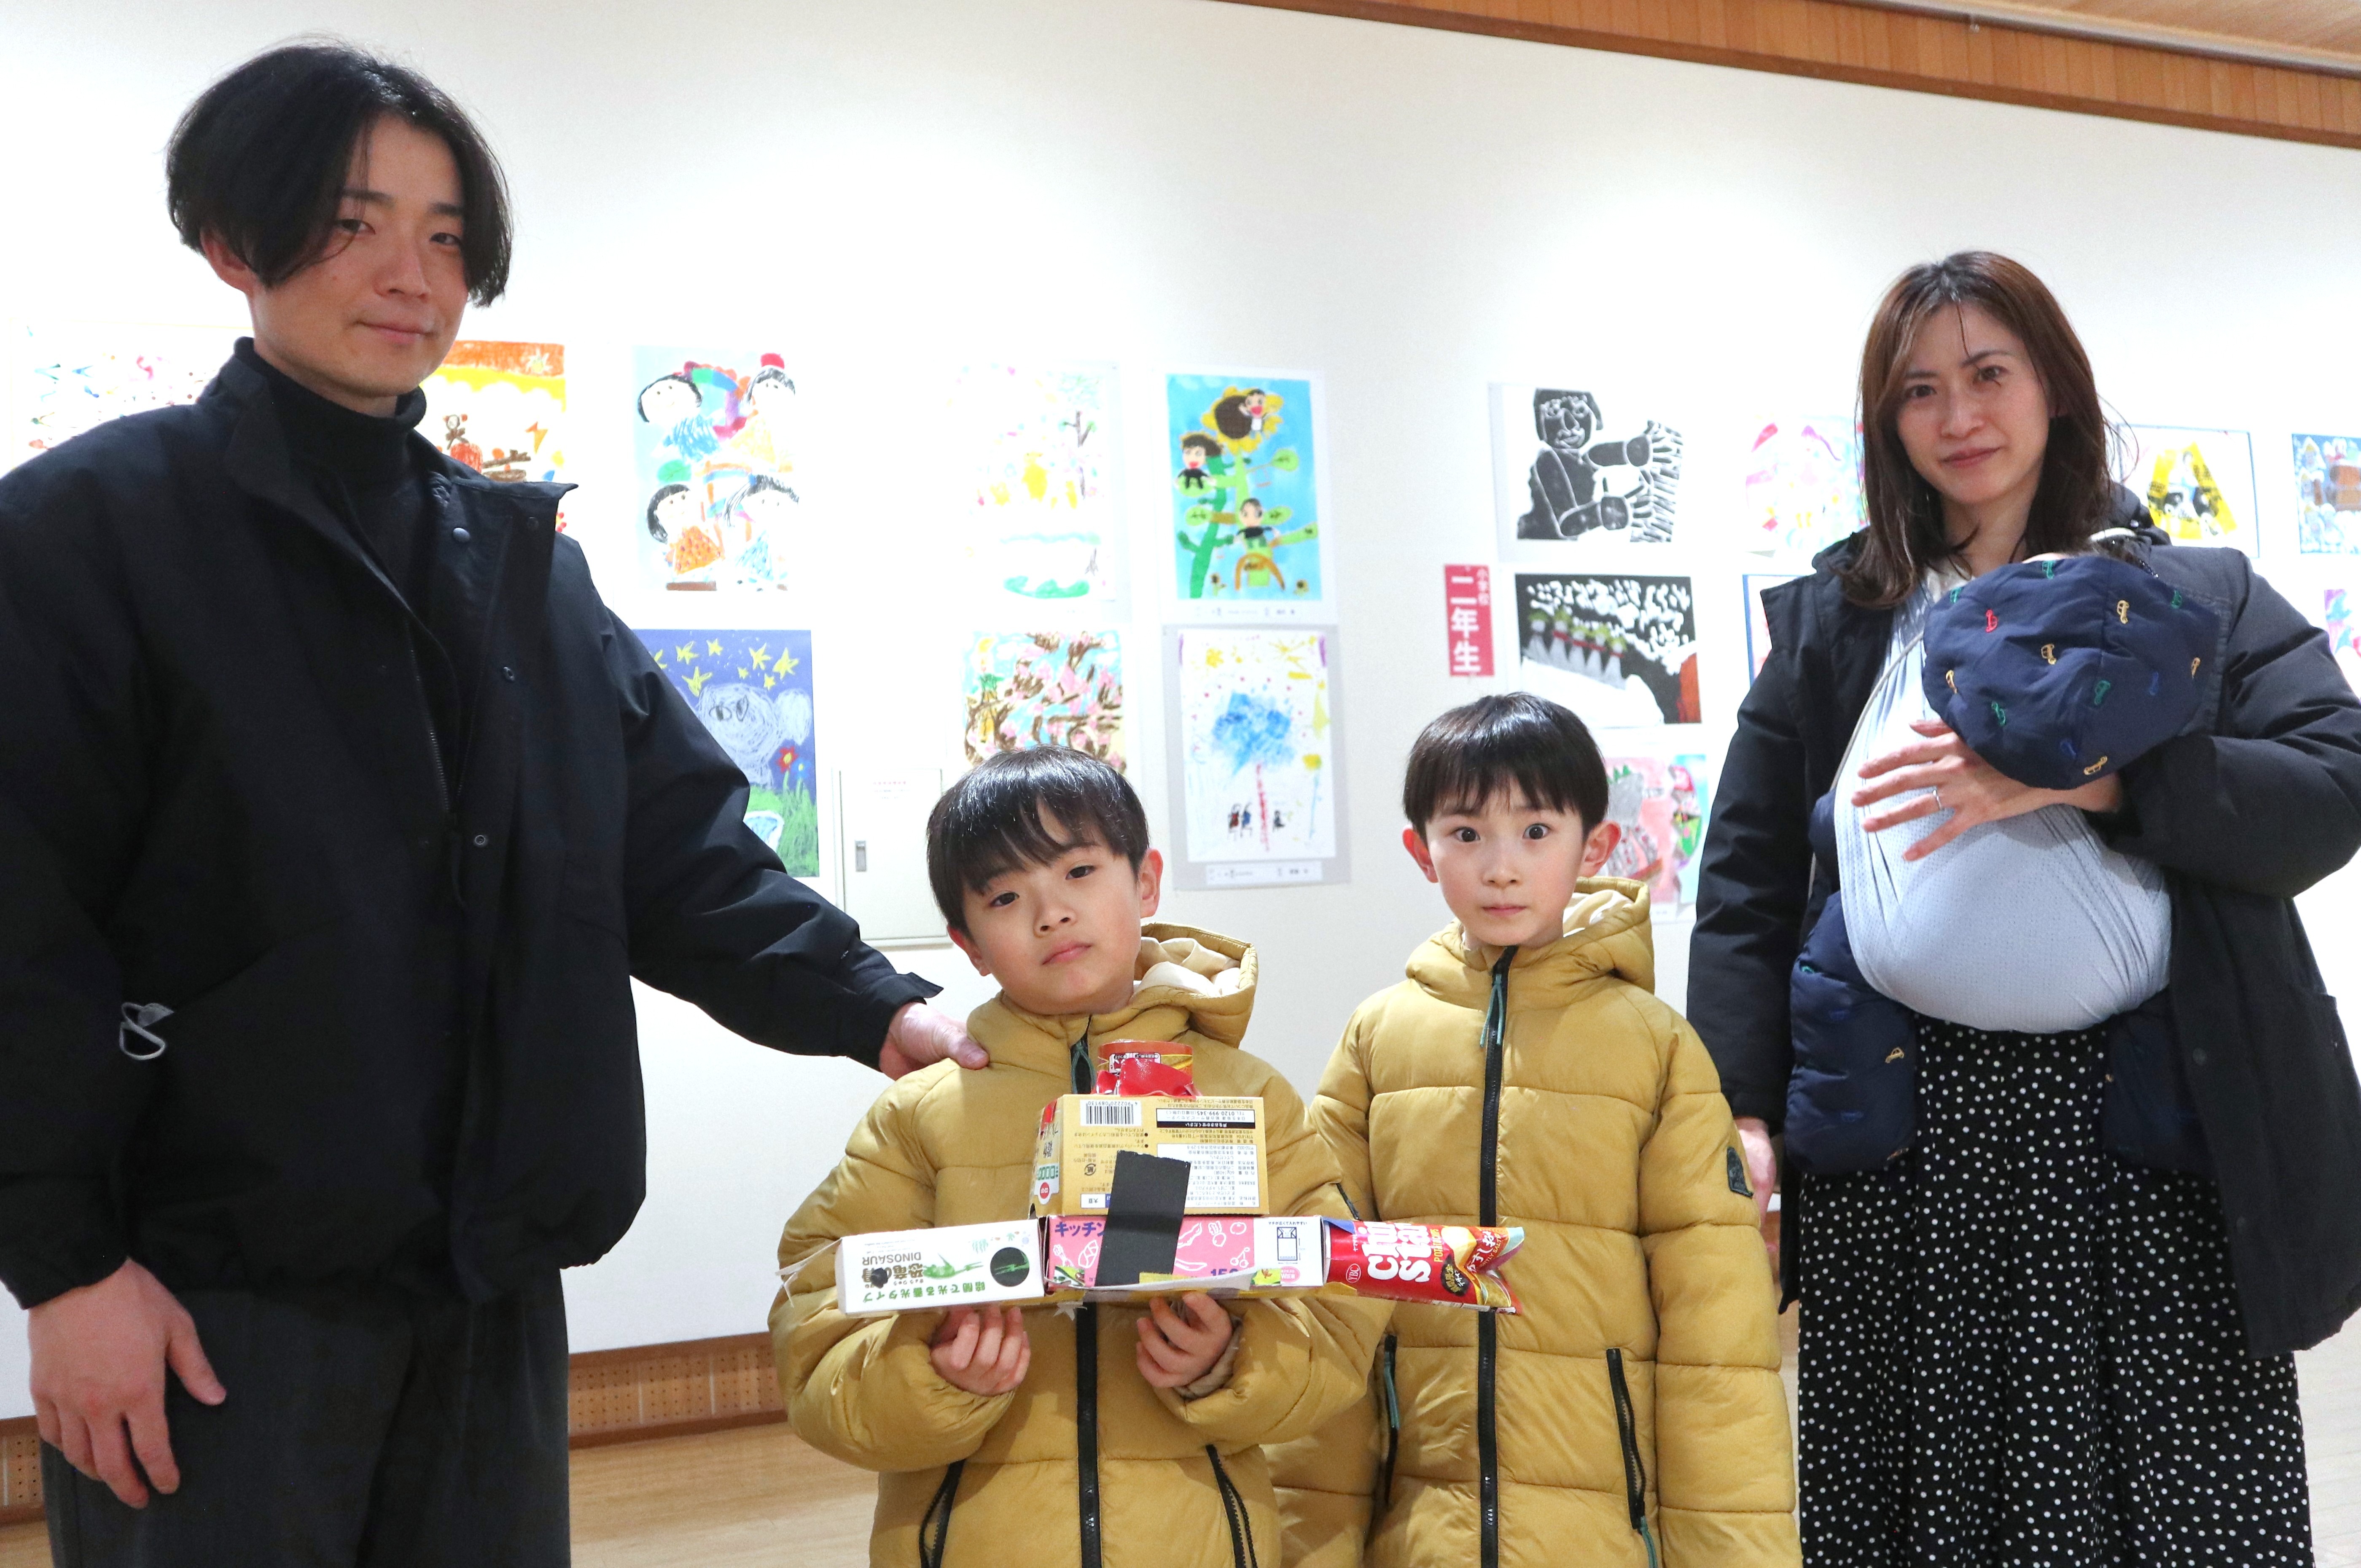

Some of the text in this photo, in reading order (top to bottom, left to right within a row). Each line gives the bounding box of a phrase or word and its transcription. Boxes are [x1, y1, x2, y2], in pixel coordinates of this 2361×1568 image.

[1450, 576, 1481, 673] 二年生
[1430, 1229, 1443, 1262] POTATO CHIPS
[862, 1252, 921, 1266] DINOSAUR
[1347, 1265, 1361, 1282] YBC
[862, 1281, 985, 1303] 暗闇で光る蓄光タイプ
